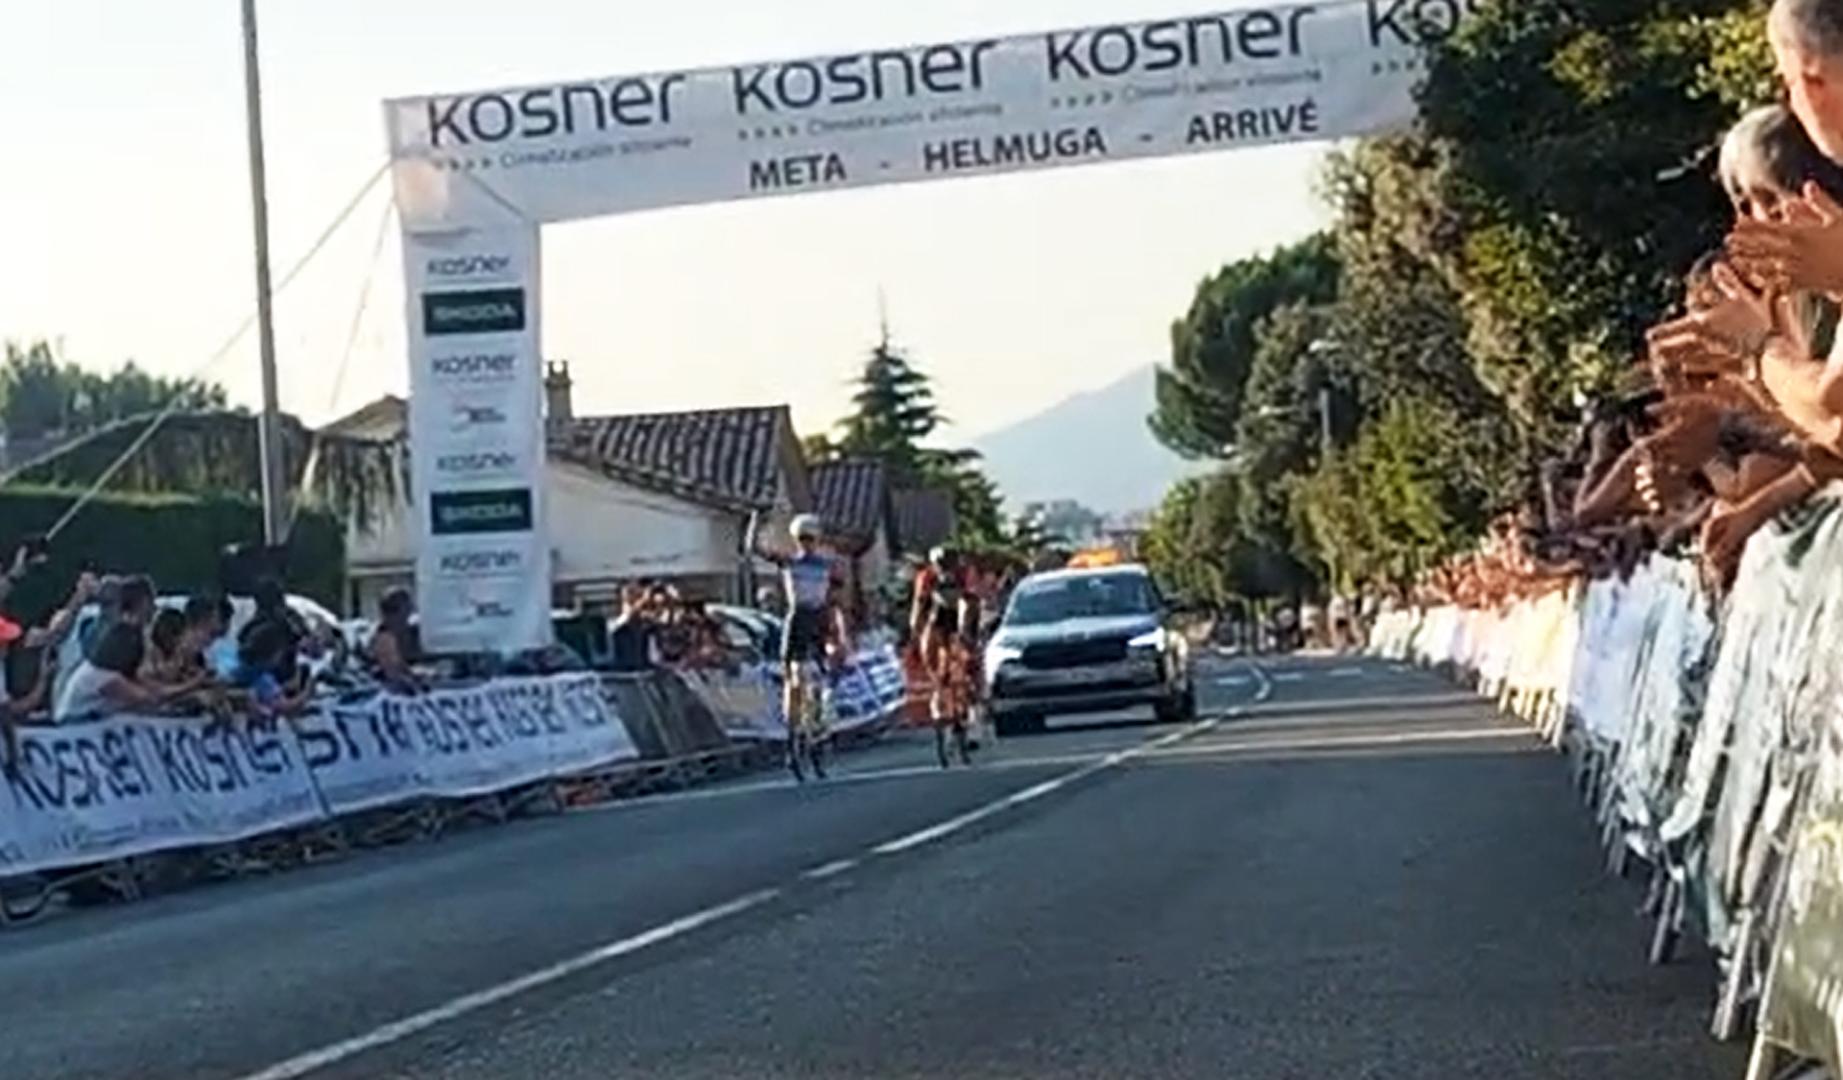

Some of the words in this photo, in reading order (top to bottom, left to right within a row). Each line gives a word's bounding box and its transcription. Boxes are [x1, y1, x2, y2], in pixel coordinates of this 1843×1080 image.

[749, 154, 847, 191] META
[923, 127, 1106, 172] HELMUGA
[1186, 97, 1318, 145] ARRIVÉ
